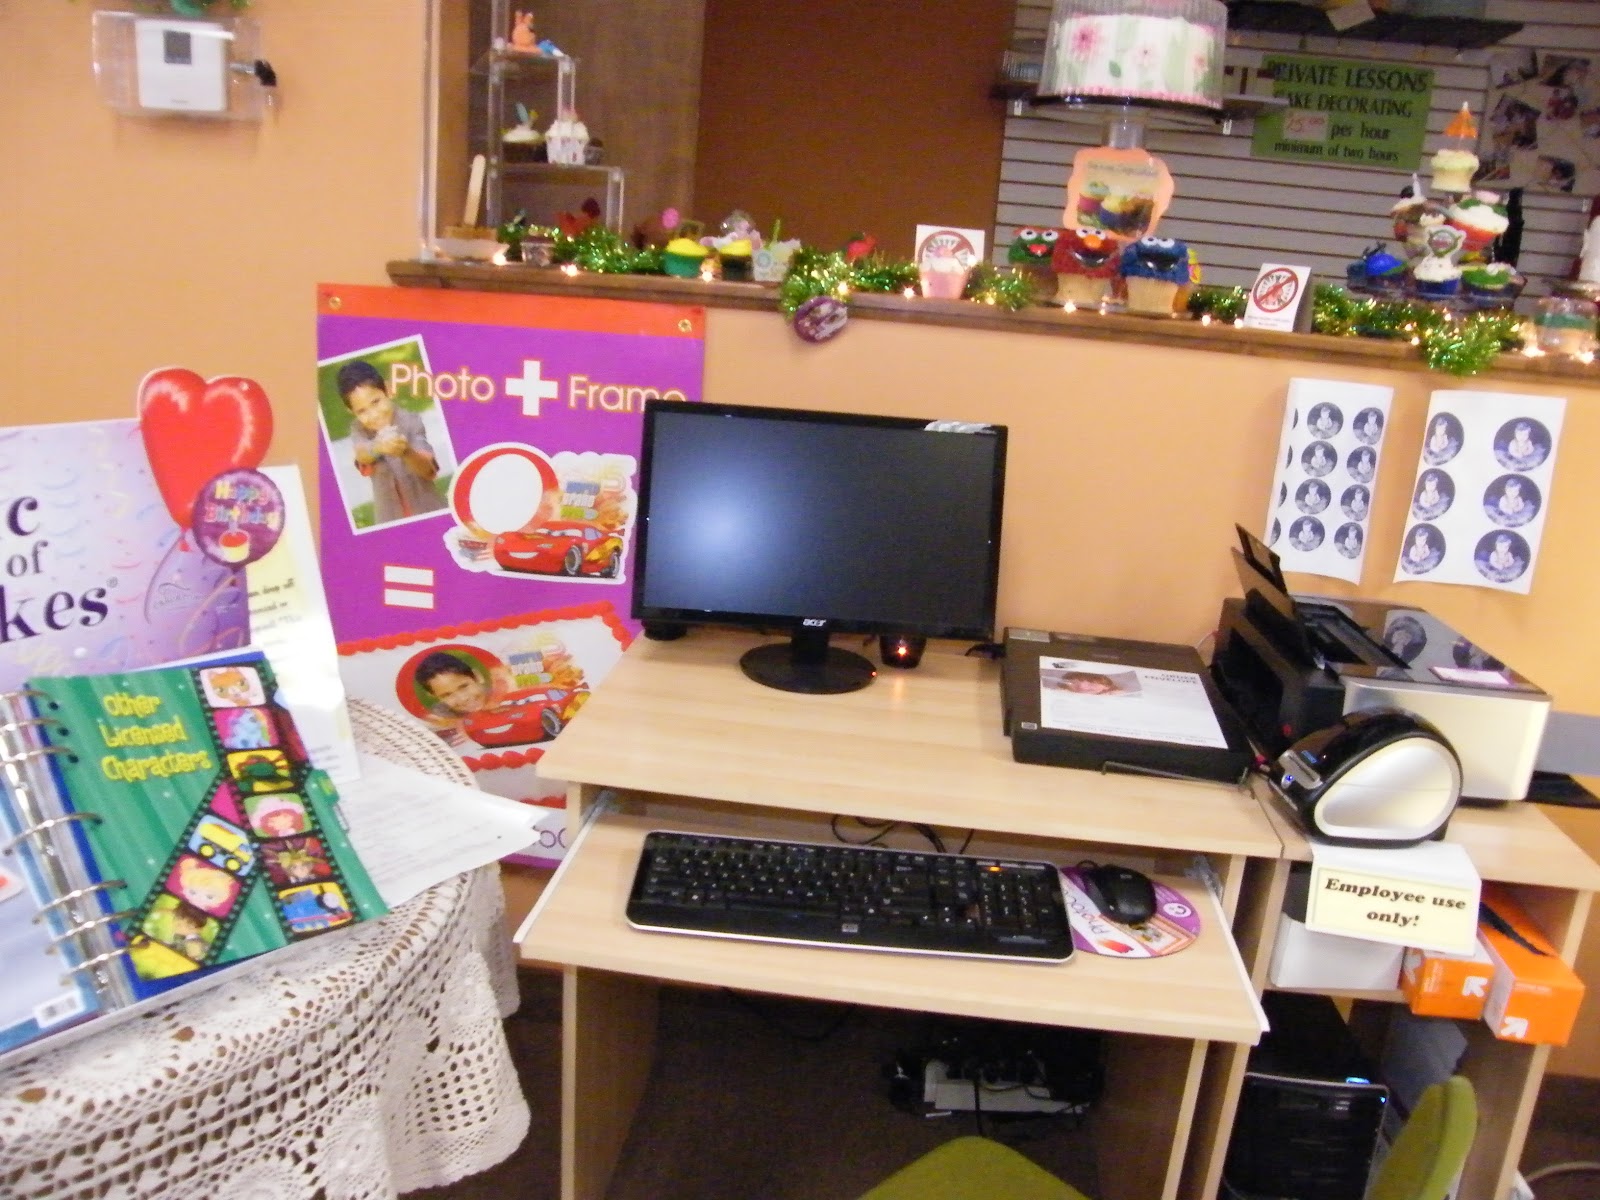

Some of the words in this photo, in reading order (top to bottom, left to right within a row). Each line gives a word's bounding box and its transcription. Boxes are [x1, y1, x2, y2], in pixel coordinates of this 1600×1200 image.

[1345, 67, 1429, 93] LESSONS
[1317, 94, 1413, 118] DECORATING
[1330, 123, 1353, 140] per
[1361, 120, 1391, 140] hour
[1274, 139, 1324, 156] minimum
[1328, 143, 1341, 157] of
[1343, 145, 1364, 160] two
[1369, 145, 1399, 161] hours
[389, 362, 497, 402] Photo
[6, 539, 49, 578] of
[103, 692, 161, 718] Other
[98, 714, 188, 748] Licensed
[101, 749, 212, 783] Characters
[1324, 877, 1426, 904] Employee
[1432, 896, 1467, 910] use
[1366, 910, 1421, 928] only!
